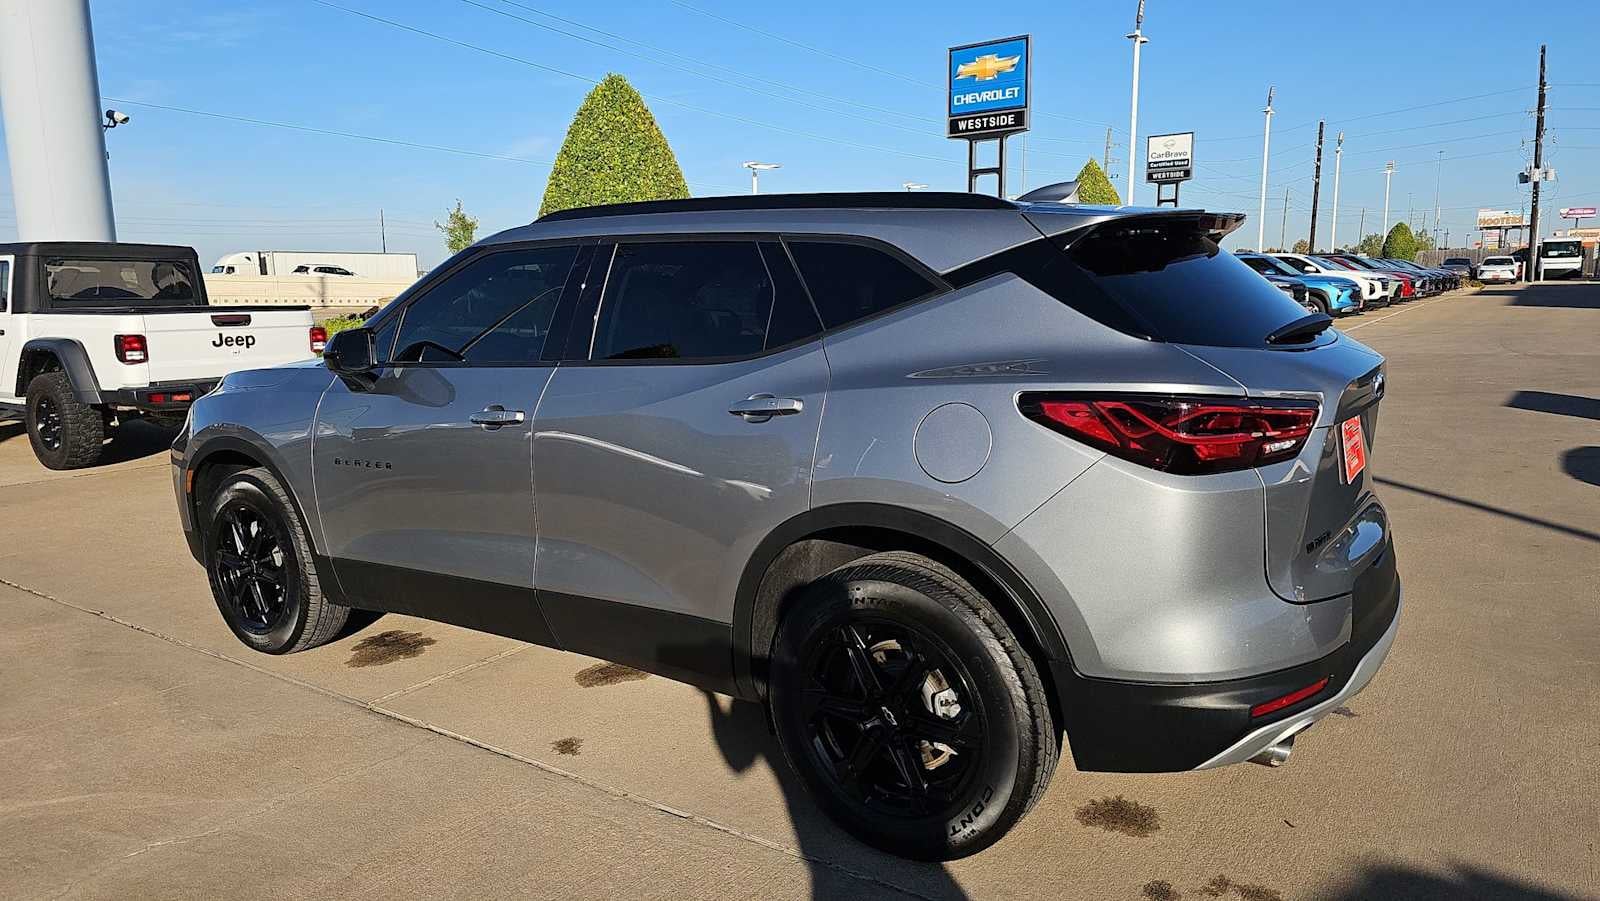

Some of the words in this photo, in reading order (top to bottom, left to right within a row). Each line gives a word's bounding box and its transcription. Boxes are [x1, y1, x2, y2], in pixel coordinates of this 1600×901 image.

[953, 86, 1020, 106] CHEVROLET
[958, 114, 1016, 131] WESTSIDE
[1150, 151, 1188, 159] CarBravo
[1152, 170, 1185, 180] WESTSIDE
[1479, 215, 1523, 226] HOOTERS
[212, 332, 256, 349] Jeep
[334, 457, 392, 470] BLAZER
